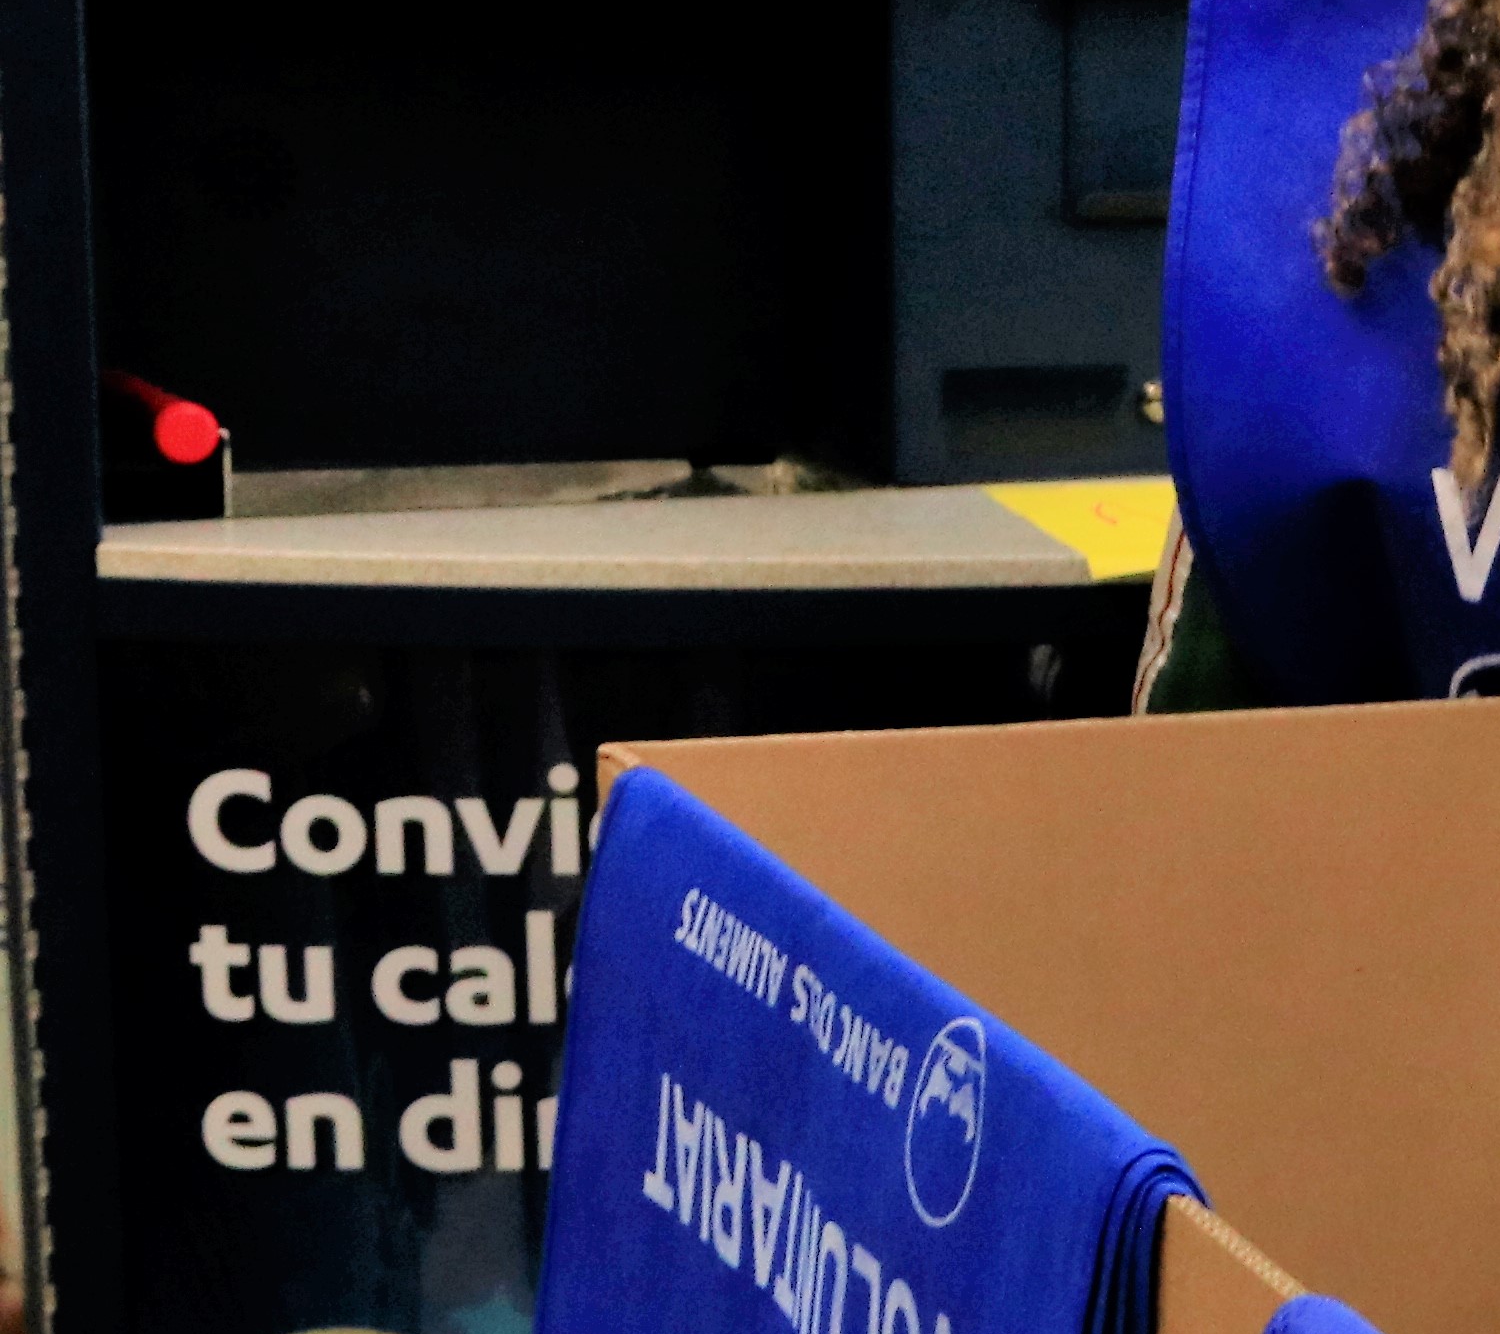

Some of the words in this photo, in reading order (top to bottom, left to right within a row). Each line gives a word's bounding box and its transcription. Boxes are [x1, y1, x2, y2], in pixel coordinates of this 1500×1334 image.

[187, 762, 600, 877] Convi
[189, 924, 336, 1026] tu
[201, 1090, 366, 1173] en
